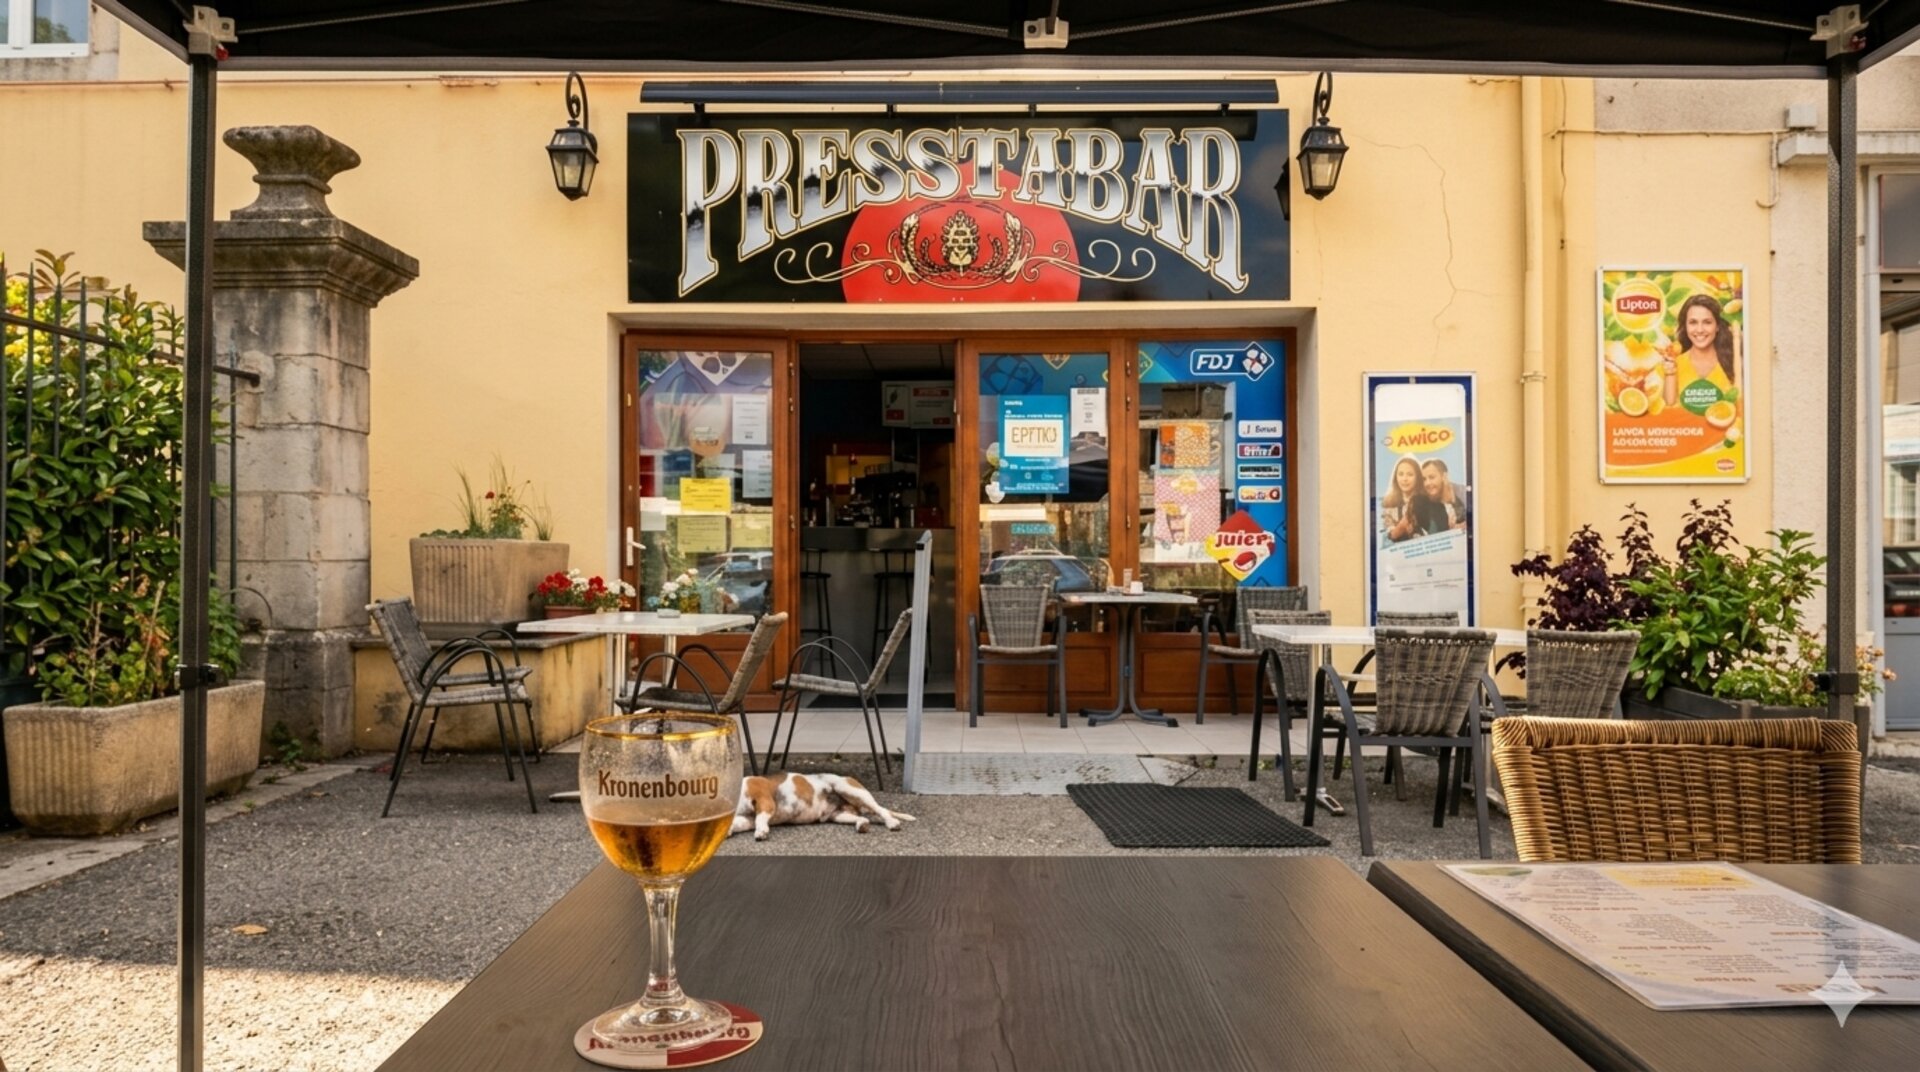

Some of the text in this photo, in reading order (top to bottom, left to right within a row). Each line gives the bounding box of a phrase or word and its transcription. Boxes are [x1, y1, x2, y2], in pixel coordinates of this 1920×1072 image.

[675, 127, 1249, 297] PRESSTABAR
[1196, 354, 1235, 370] FDJ
[598, 769, 718, 800] Kronenbourg
